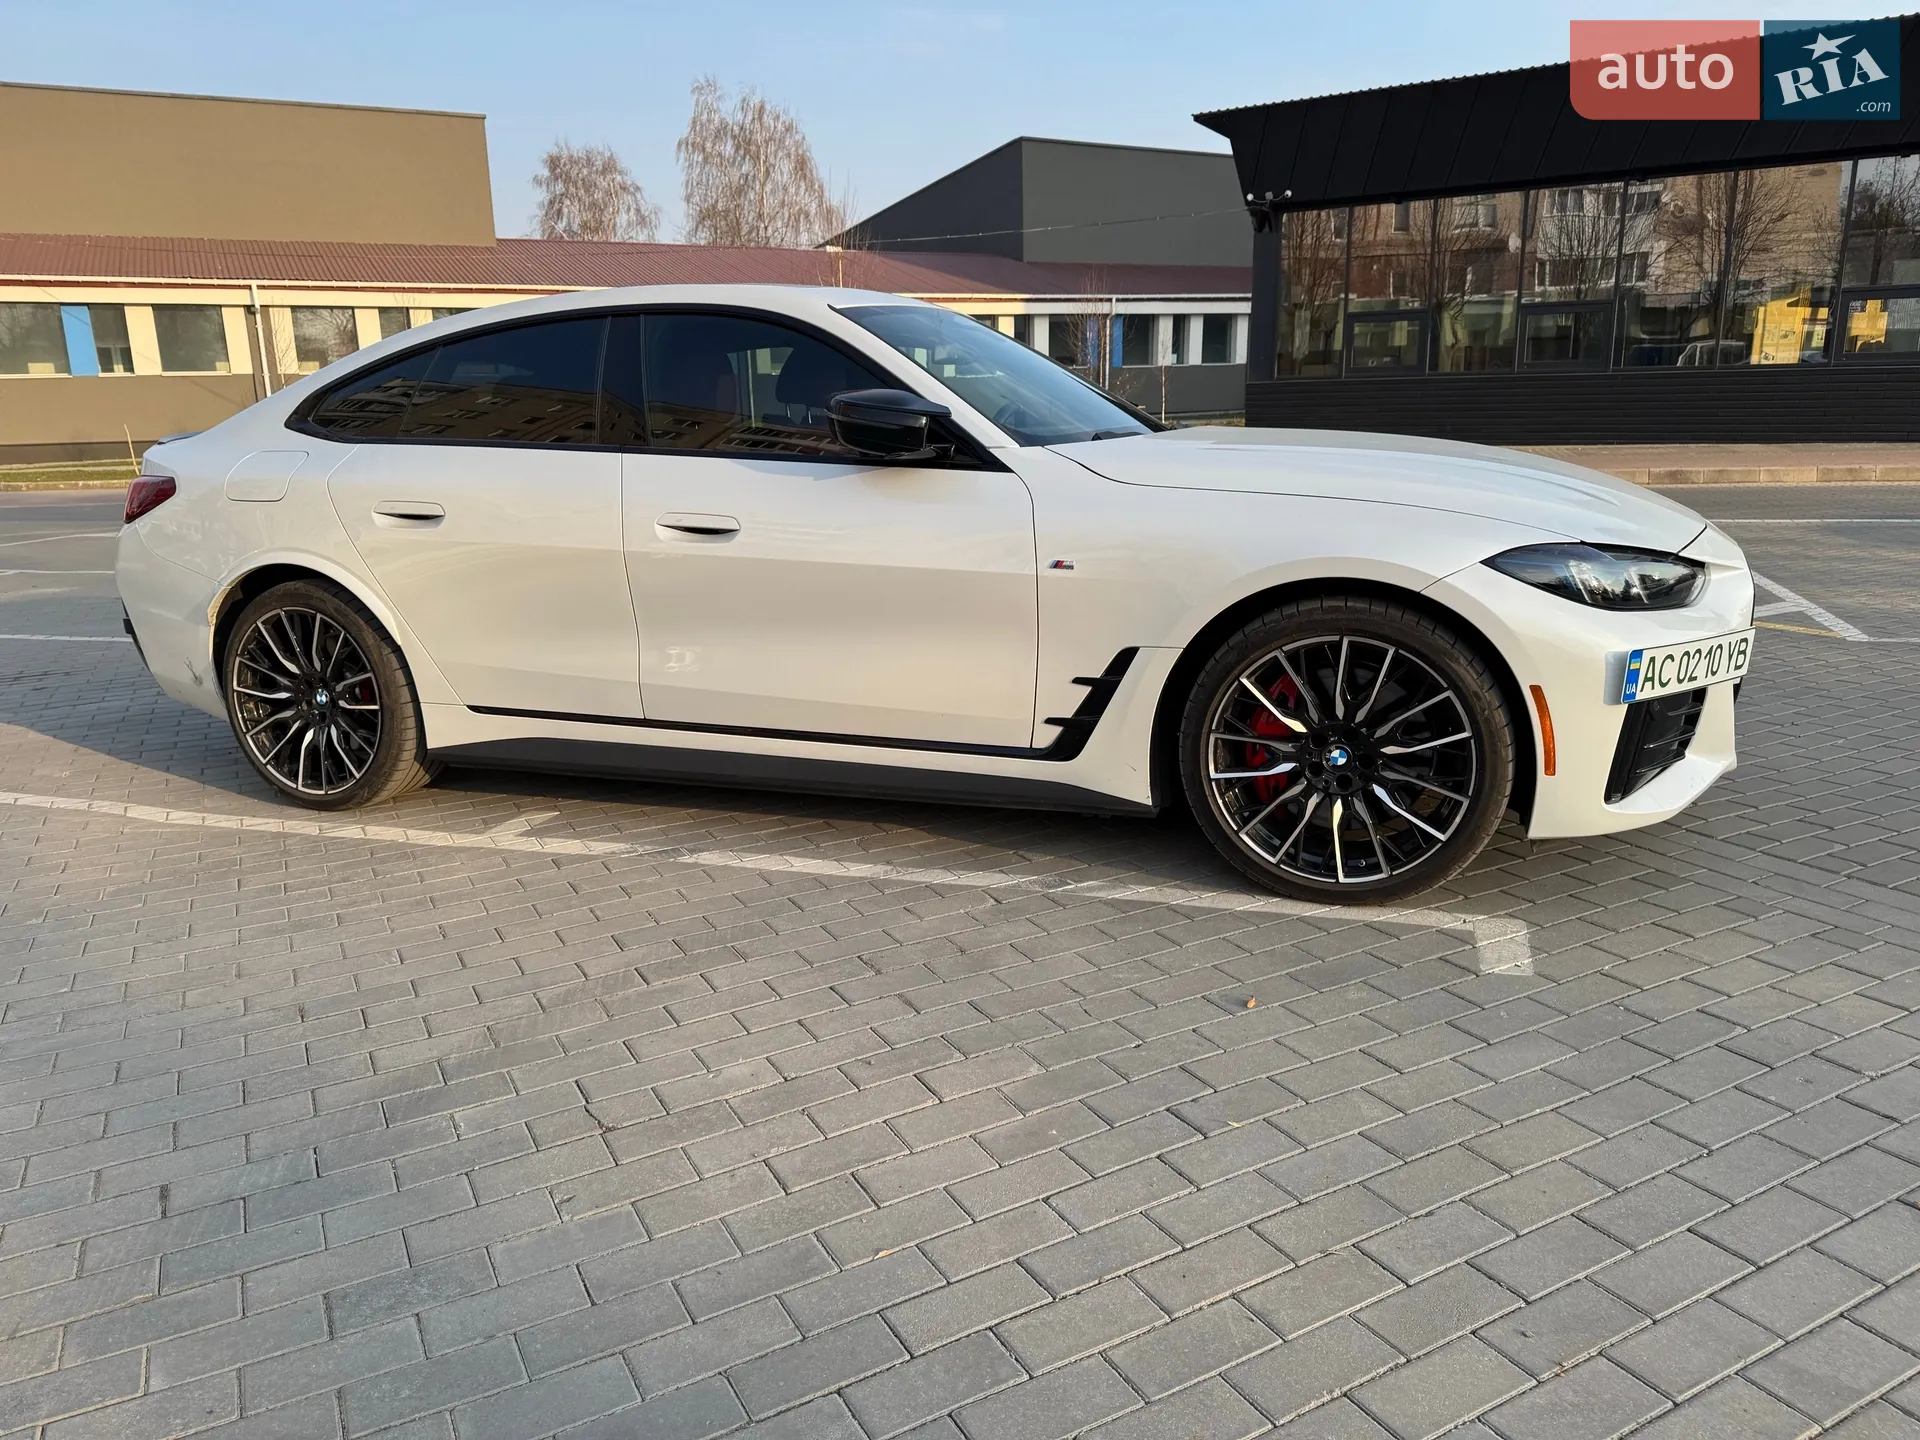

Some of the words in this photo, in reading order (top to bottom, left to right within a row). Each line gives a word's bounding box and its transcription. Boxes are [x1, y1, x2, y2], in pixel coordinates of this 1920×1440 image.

[1640, 654, 1675, 692] AC
[1676, 643, 1723, 685] 0210
[1726, 637, 1749, 674] YB
[1626, 684, 1636, 694] UA
